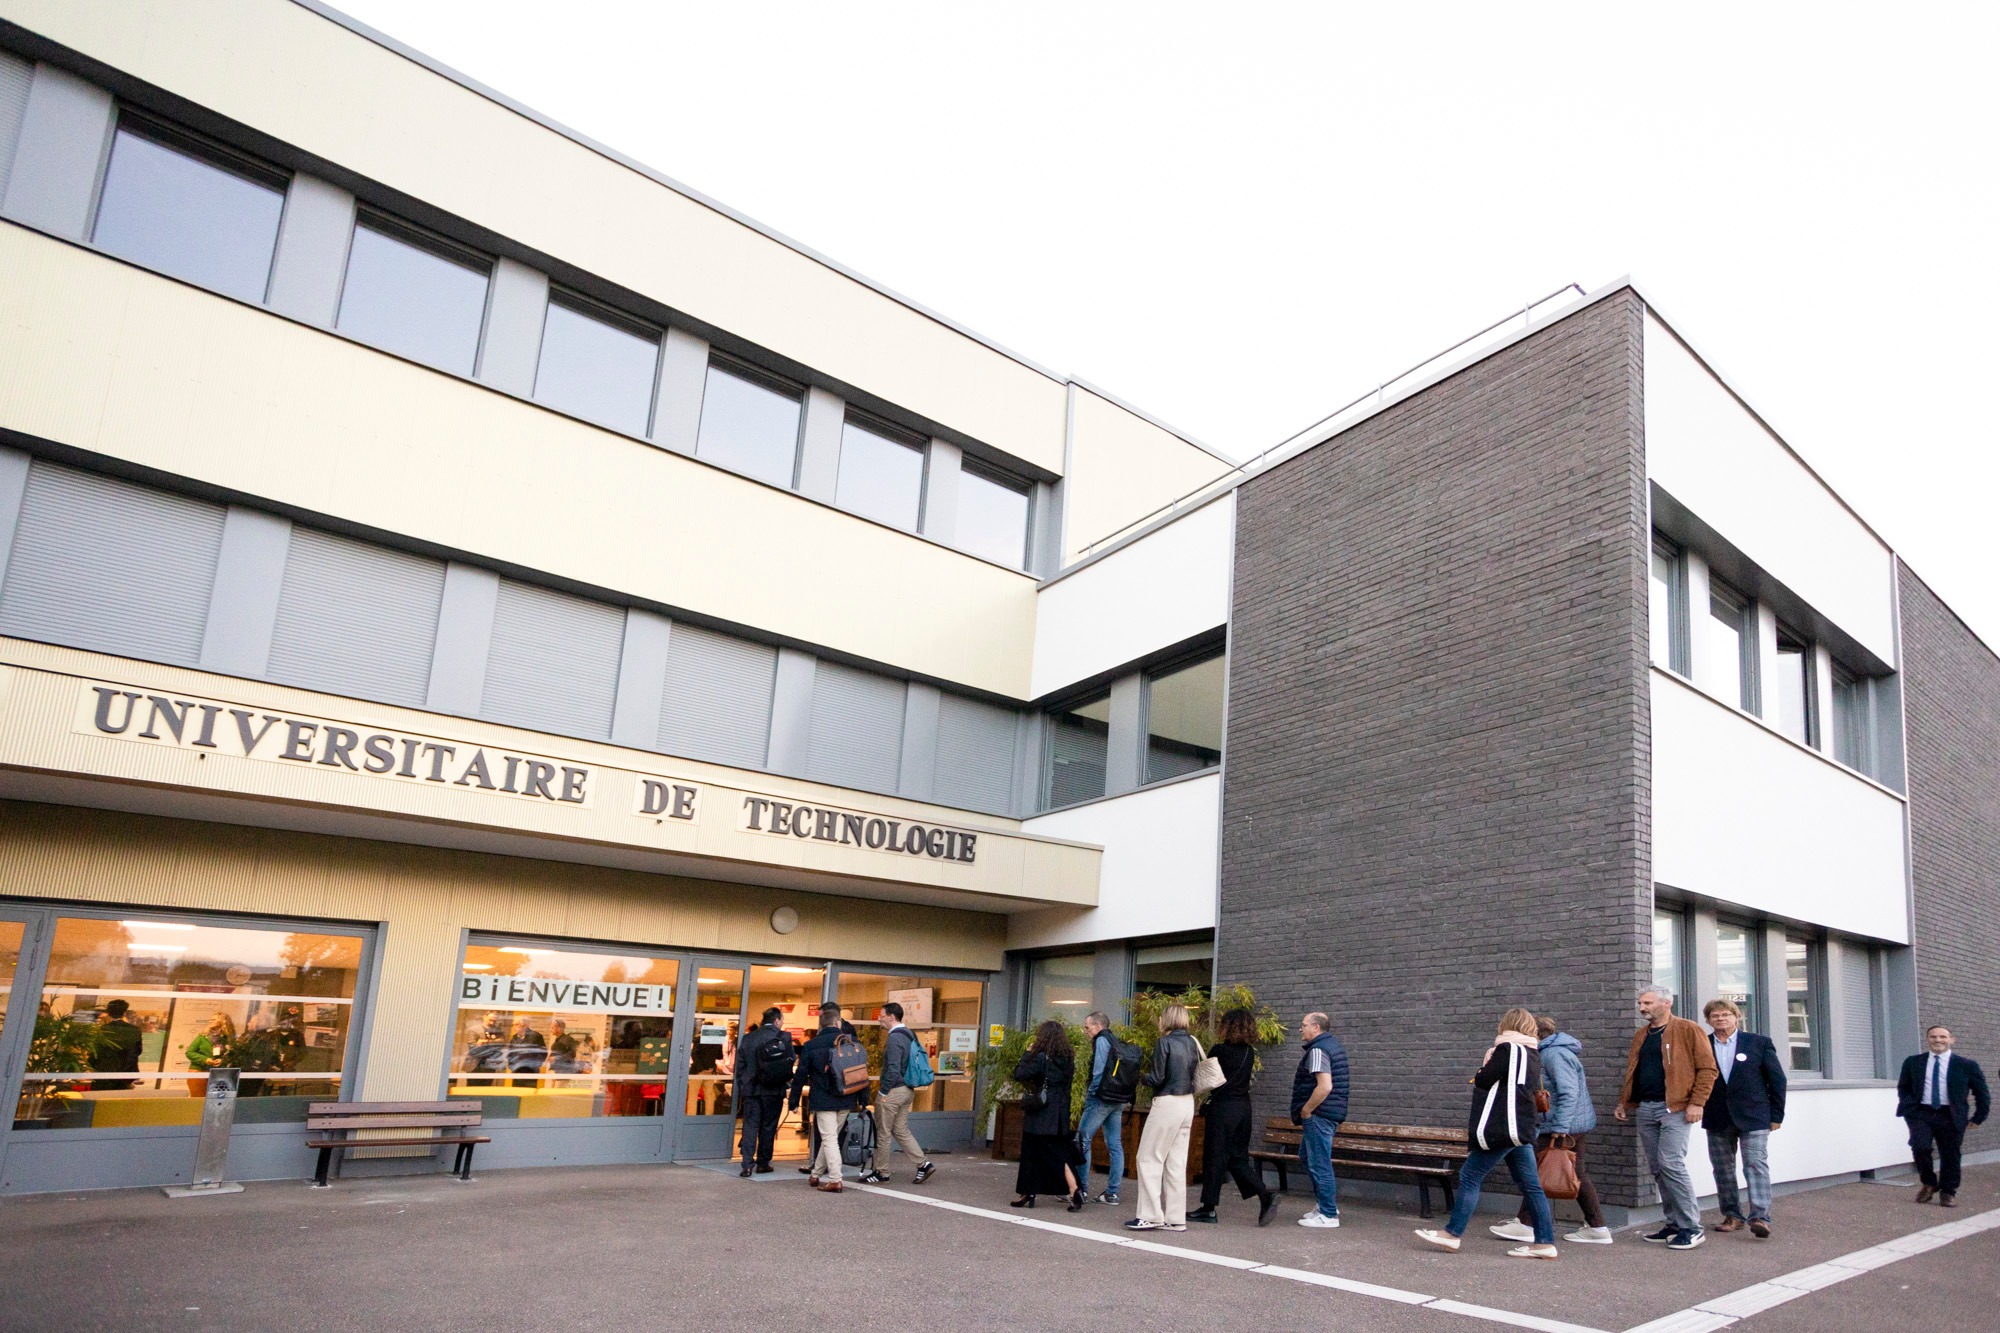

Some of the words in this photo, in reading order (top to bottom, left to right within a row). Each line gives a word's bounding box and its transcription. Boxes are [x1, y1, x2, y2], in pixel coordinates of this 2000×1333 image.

[92, 685, 589, 804] UNIVERSITAIRE
[640, 779, 698, 820] DE
[744, 796, 978, 863] TECHNOLOGIE
